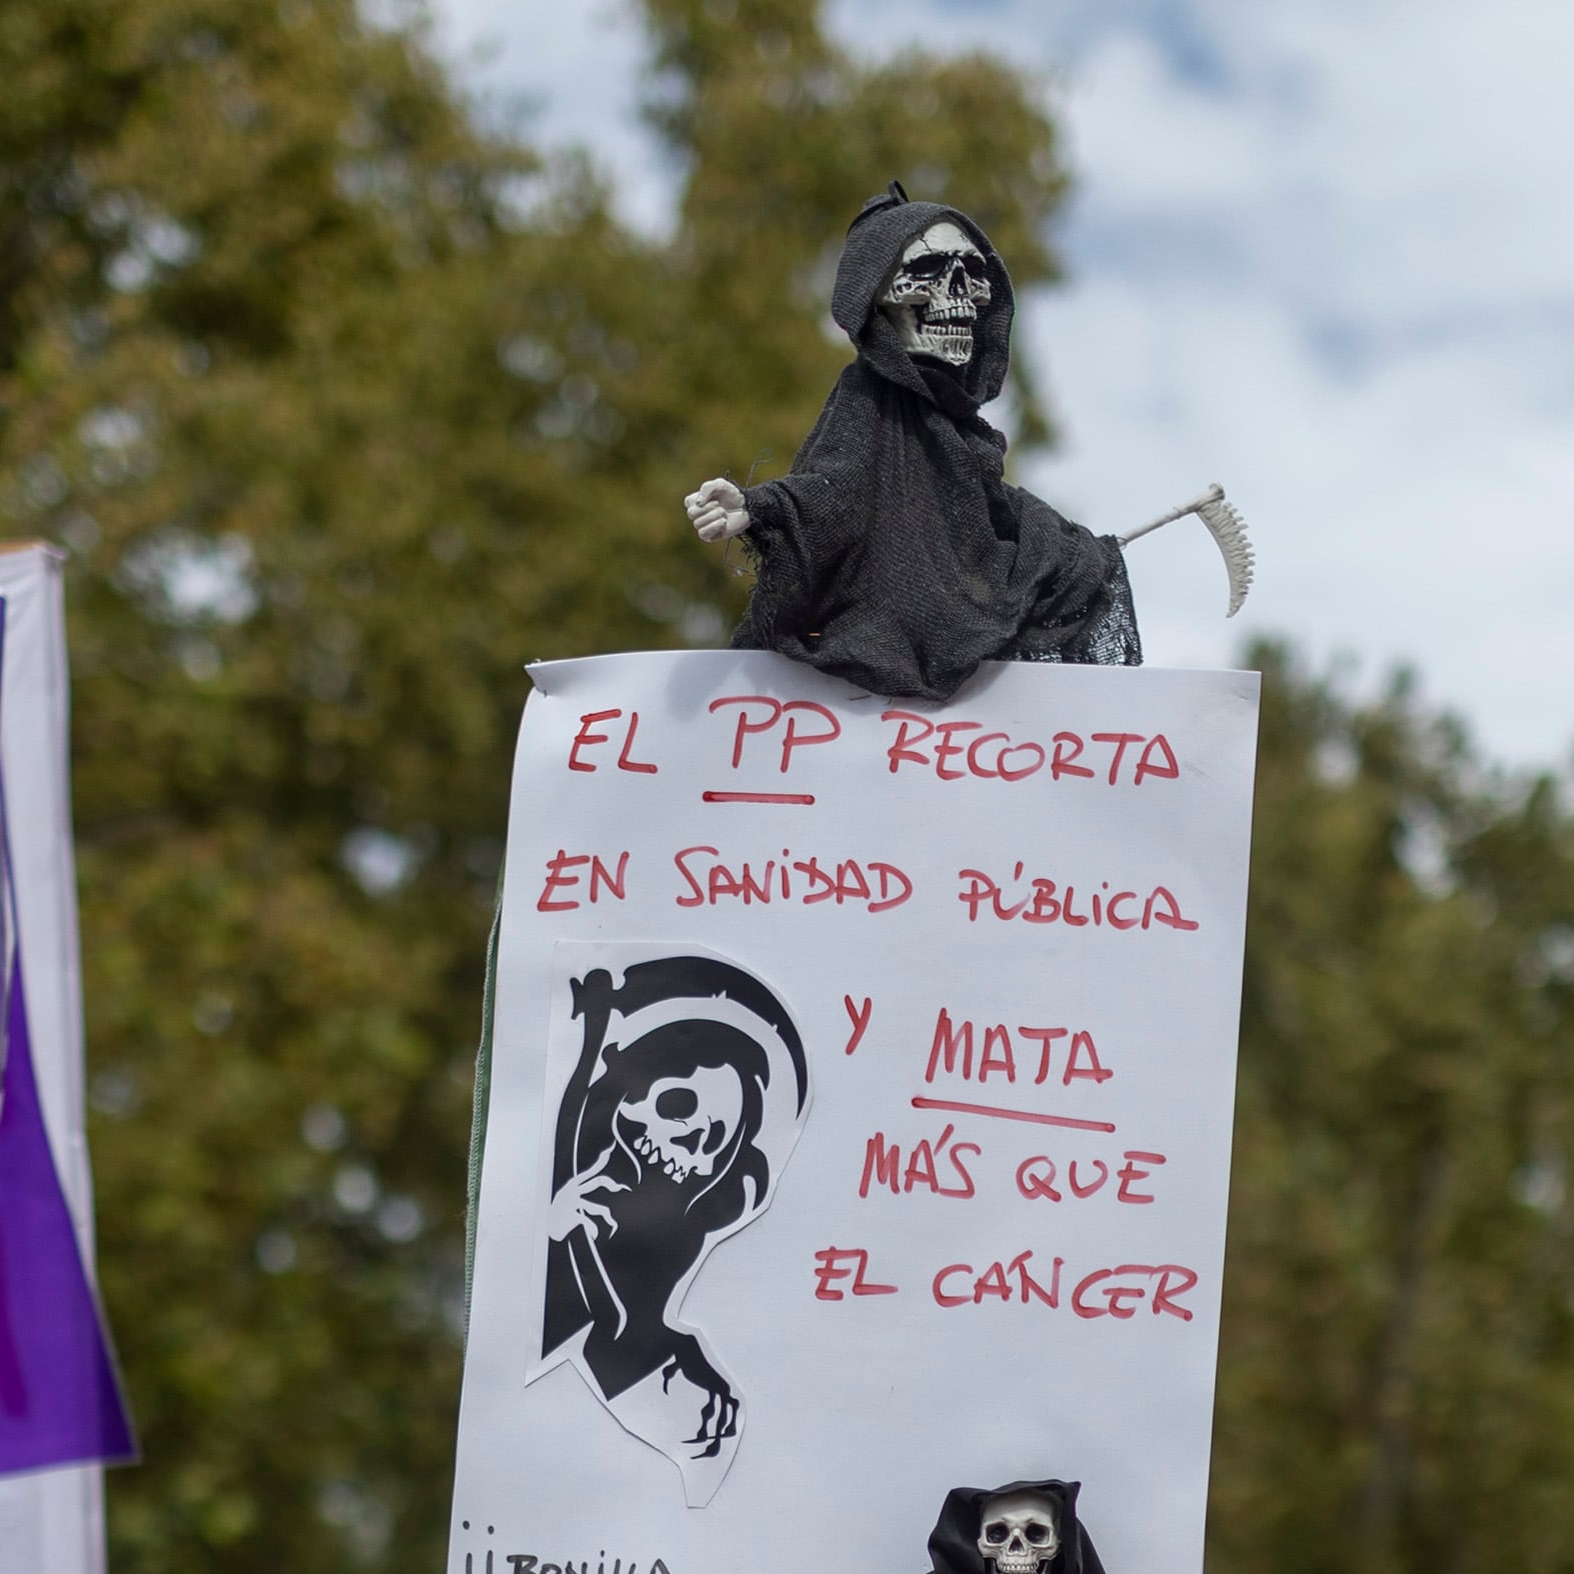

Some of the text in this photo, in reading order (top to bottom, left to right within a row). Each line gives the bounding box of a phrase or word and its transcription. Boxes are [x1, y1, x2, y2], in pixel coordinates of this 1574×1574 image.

[567, 695, 1181, 786] EL PP RECORTA
[536, 849, 630, 912] EN
[925, 1006, 1115, 1087] MATA
[858, 1122, 1168, 1205] MÁS QUE
[813, 1244, 1199, 1323] EL CÁNCER
